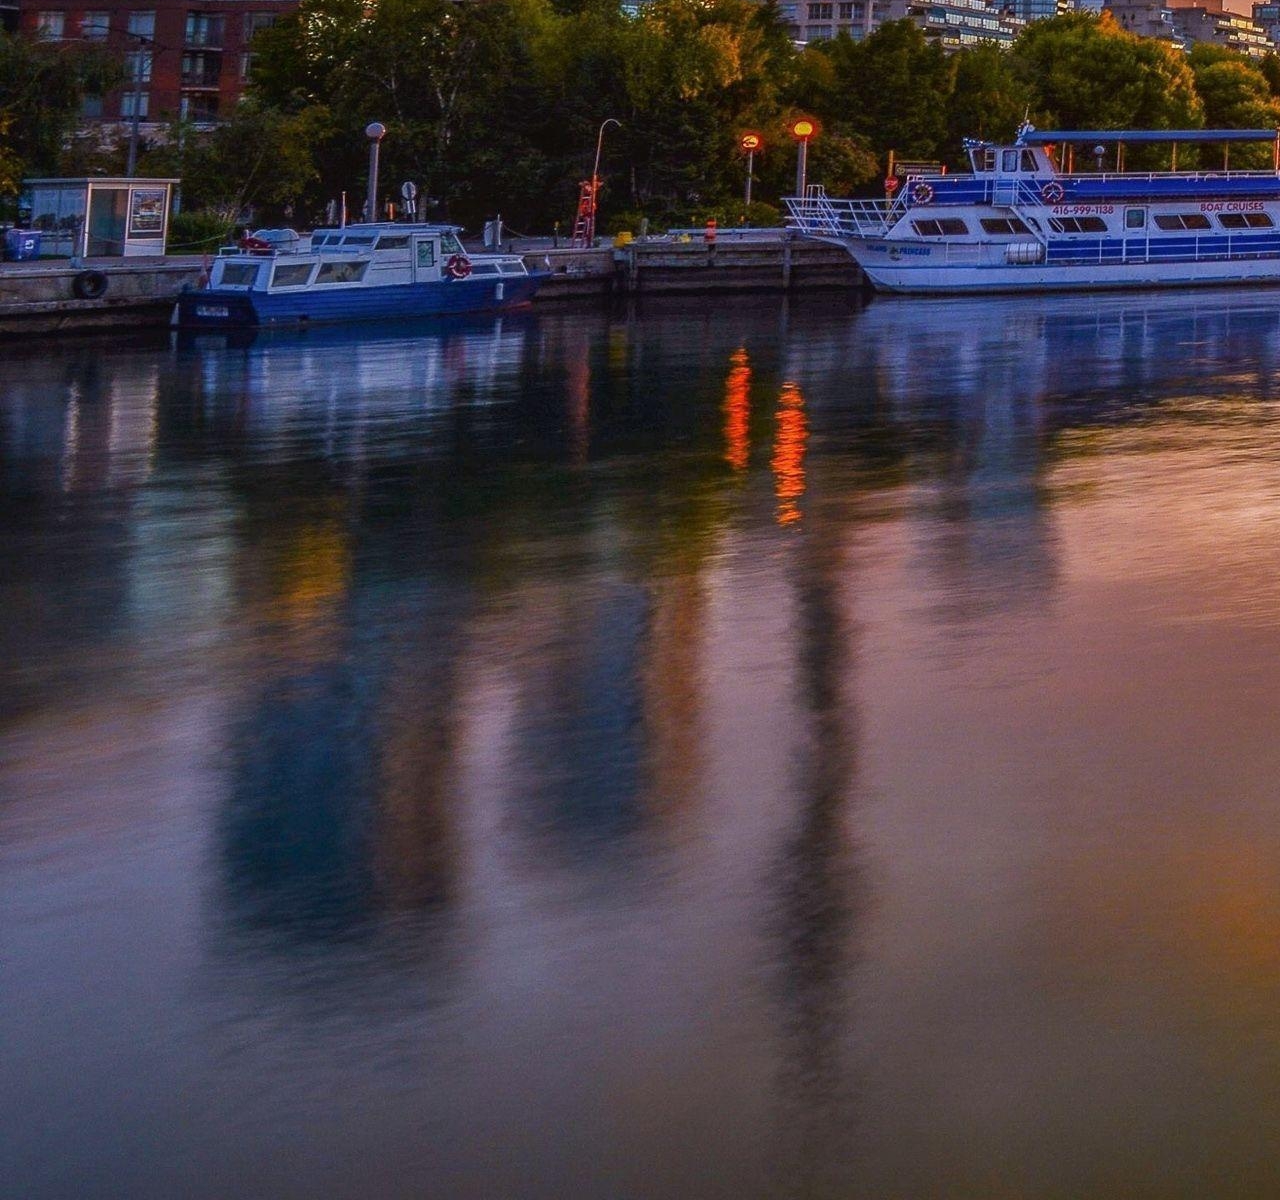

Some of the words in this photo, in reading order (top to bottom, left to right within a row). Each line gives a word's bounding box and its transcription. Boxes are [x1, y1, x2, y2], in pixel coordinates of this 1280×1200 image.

[1052, 204, 1114, 215] 416-999-1138
[1200, 202, 1224, 212] BOAT
[1226, 202, 1265, 212] CRUISES
